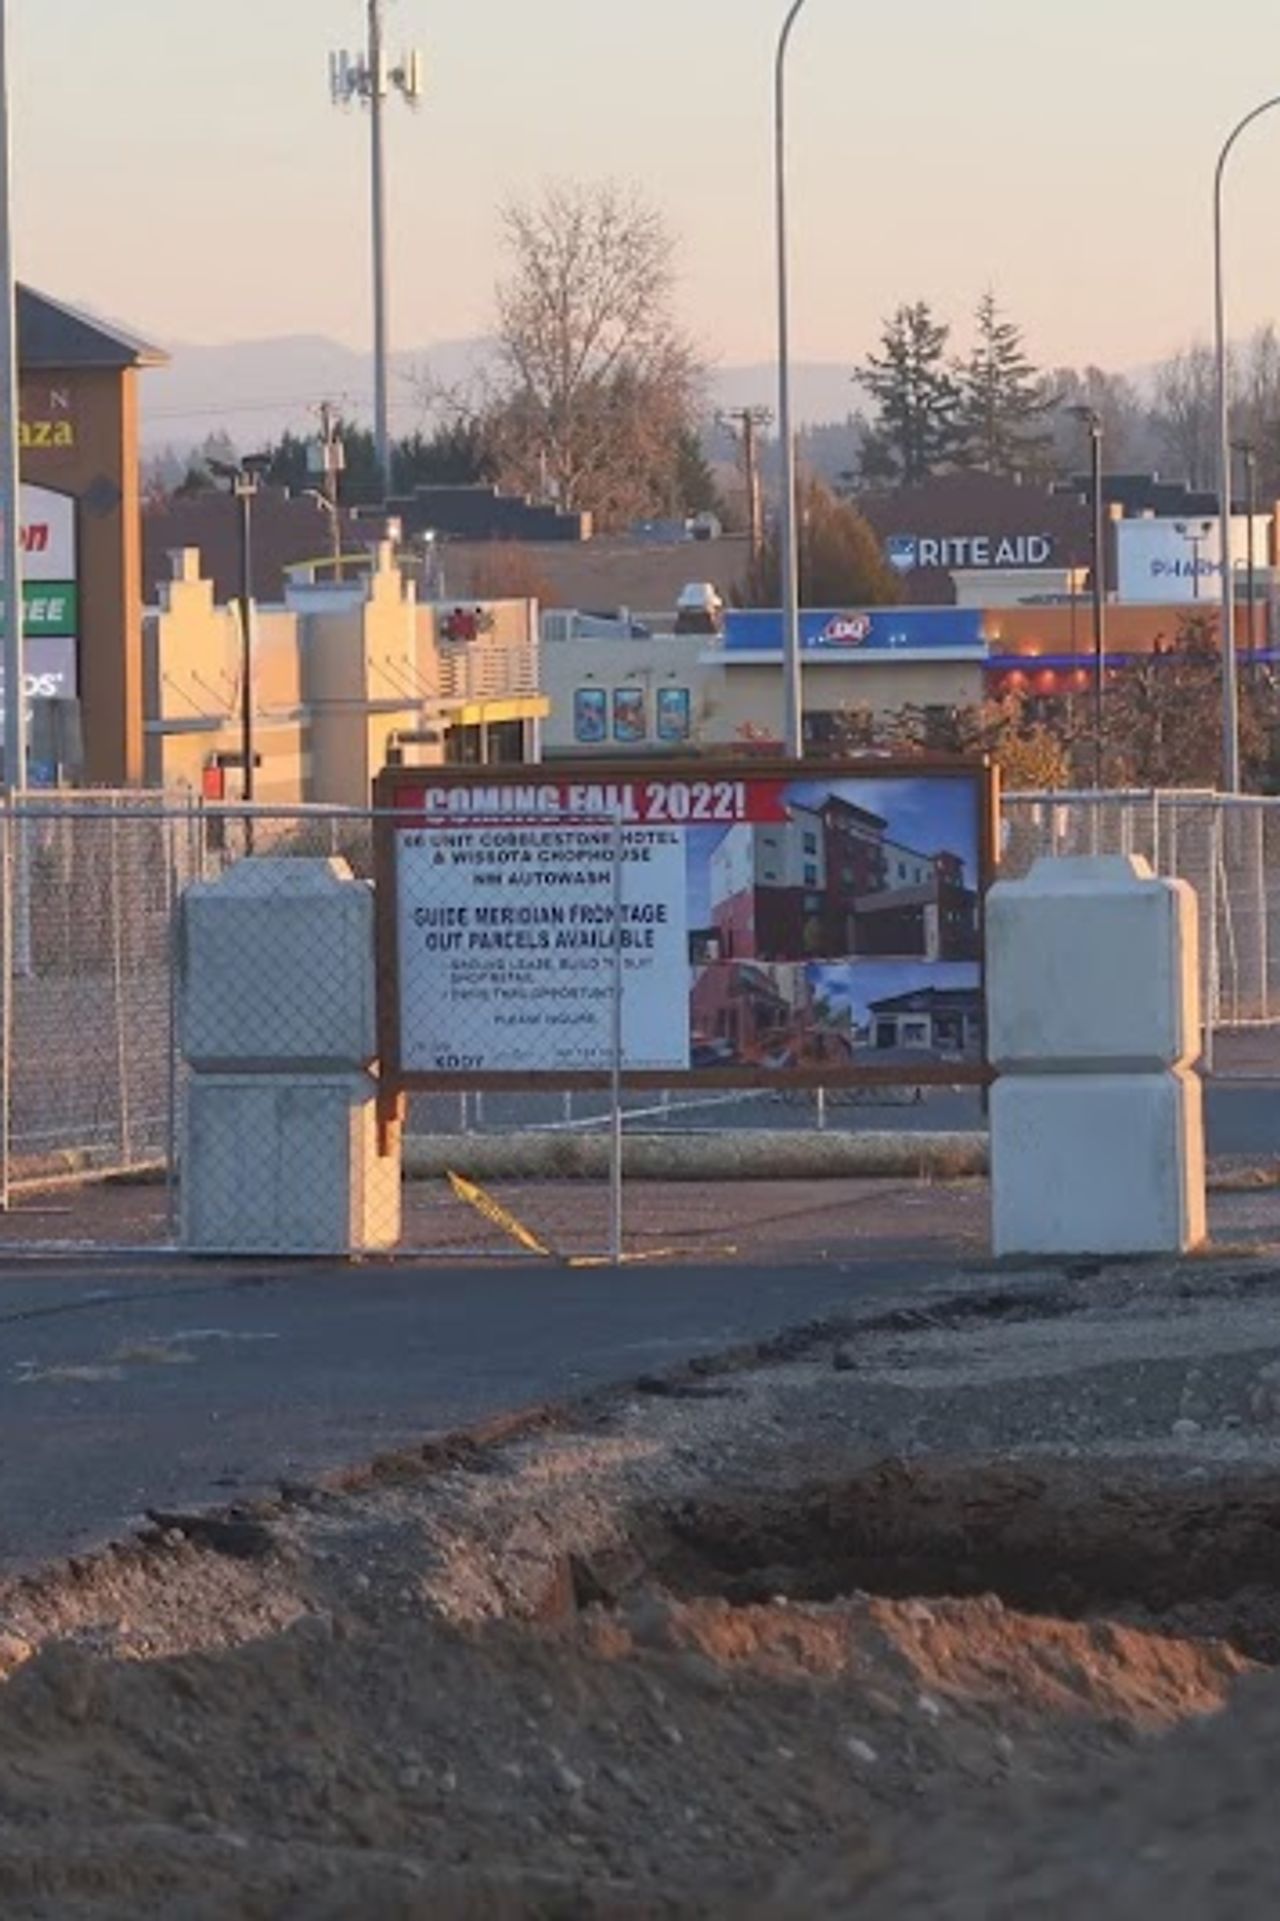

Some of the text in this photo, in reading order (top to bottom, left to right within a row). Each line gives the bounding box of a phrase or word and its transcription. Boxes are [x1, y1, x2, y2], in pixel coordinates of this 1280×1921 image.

[919, 536, 1050, 566] RITE AID
[425, 781, 746, 824] COMING FALL 2022!
[430, 832, 473, 848] UNIT
[619, 831, 679, 845] HOTEL
[451, 850, 532, 865] WISSOTA
[508, 870, 611, 888] AUTOWASH
[414, 906, 469, 927] GUIDE
[475, 906, 564, 924] MERIDIAN
[425, 932, 463, 951] OUT
[468, 931, 550, 949] PARCELS
